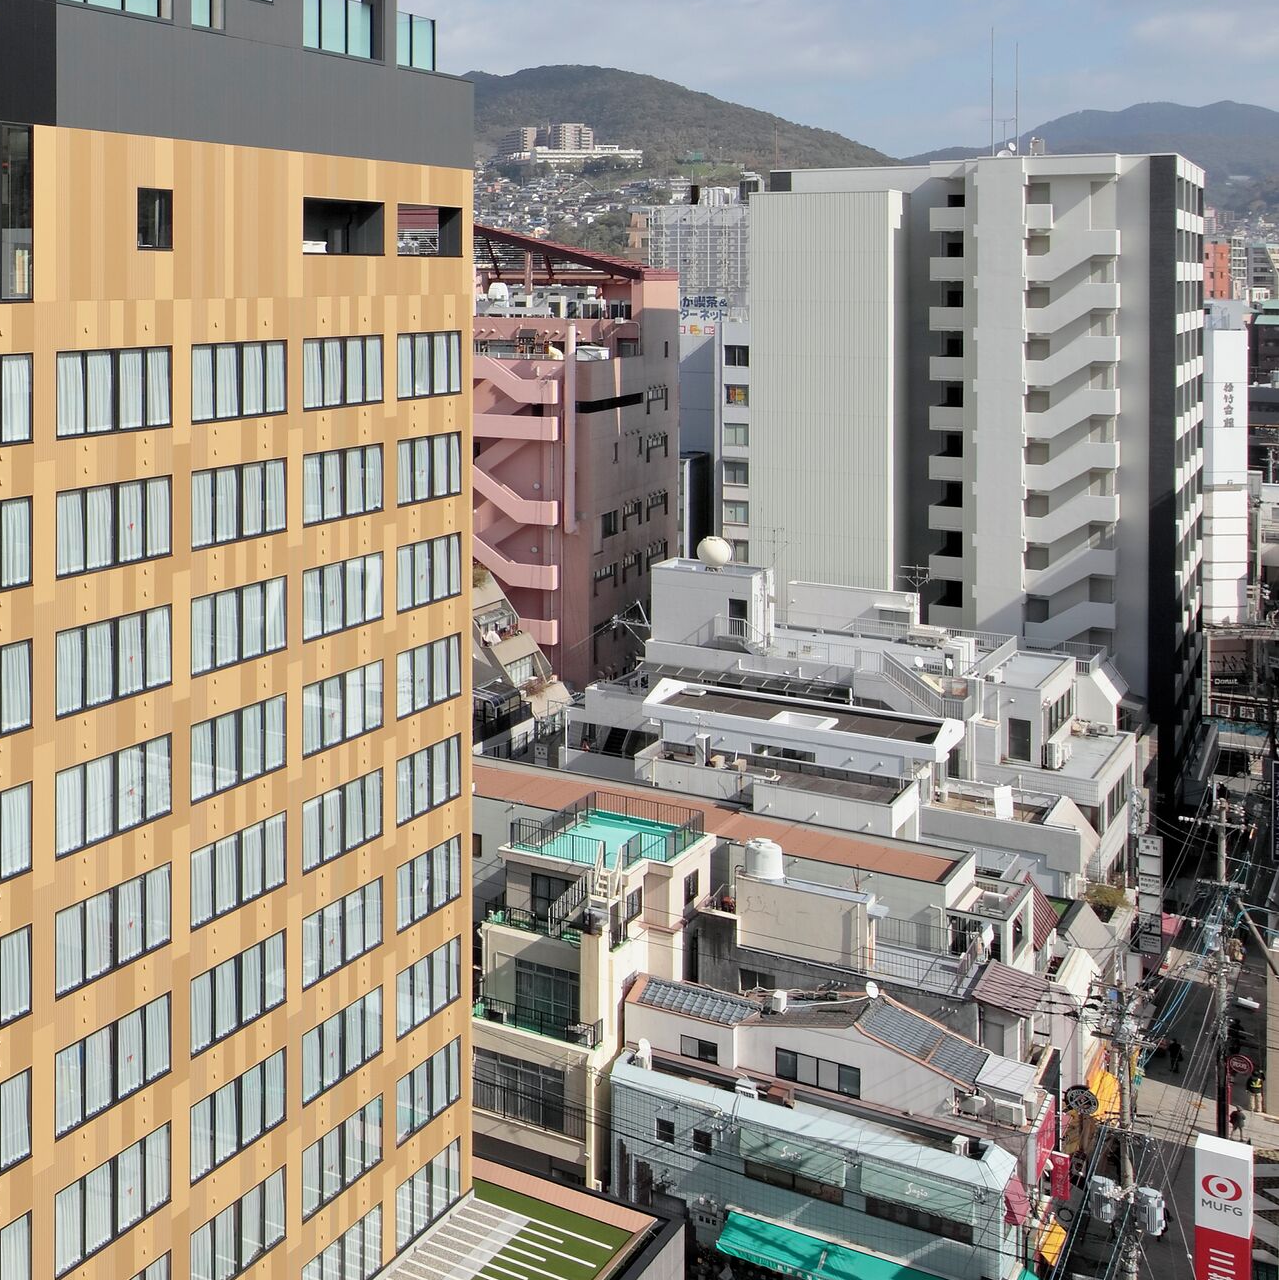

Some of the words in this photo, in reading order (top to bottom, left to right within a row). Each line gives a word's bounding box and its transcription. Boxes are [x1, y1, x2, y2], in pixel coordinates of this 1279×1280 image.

[680, 296, 728, 308] が喫茶&
[1201, 1198, 1243, 1217] MUFG
